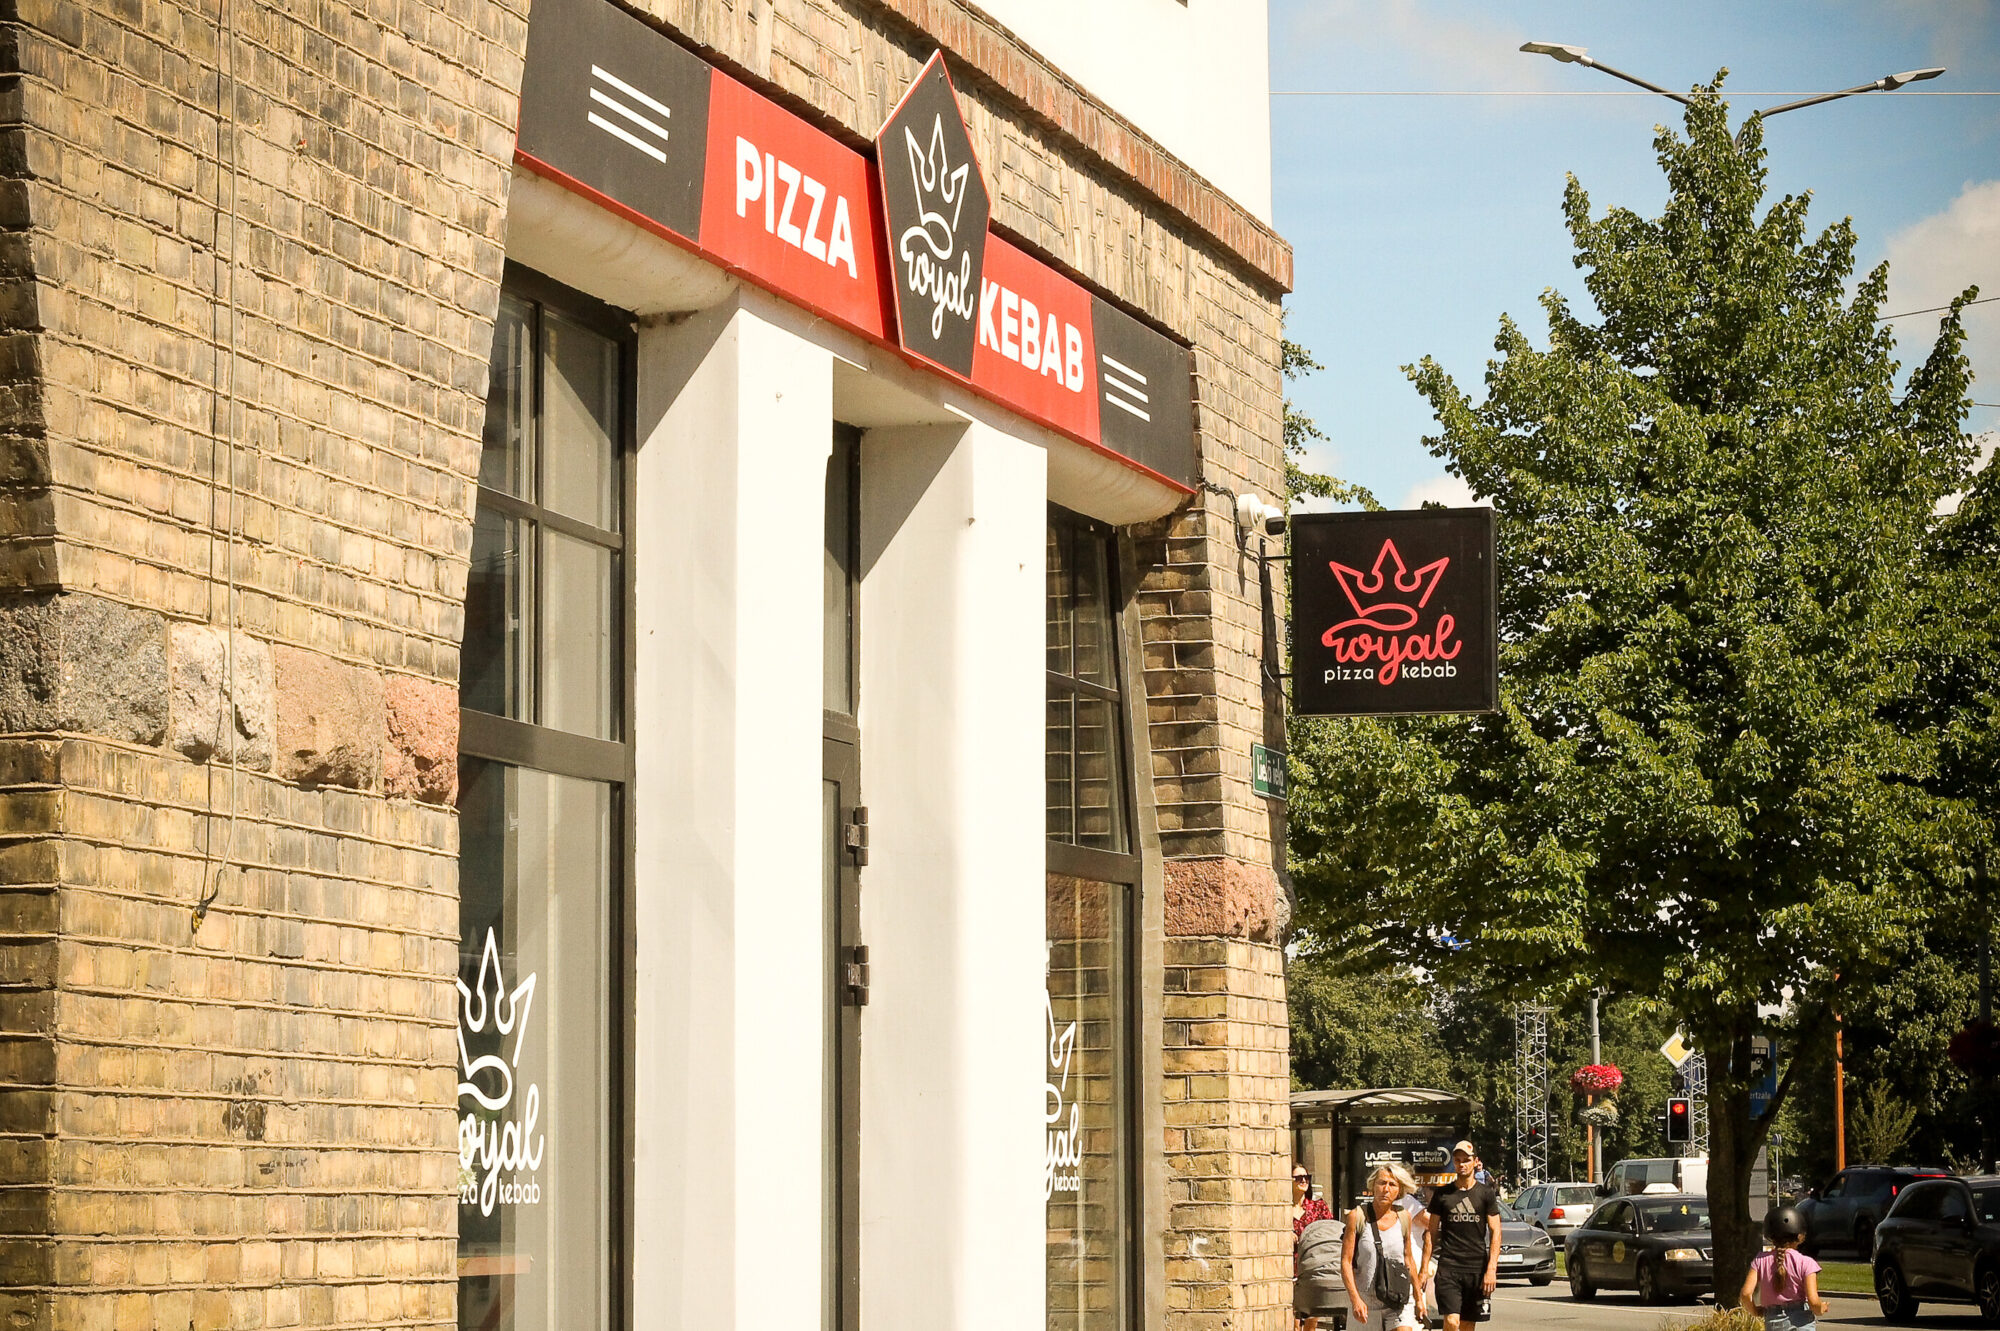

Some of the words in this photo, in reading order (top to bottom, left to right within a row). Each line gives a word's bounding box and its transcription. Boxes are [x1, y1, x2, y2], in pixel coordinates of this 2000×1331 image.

[736, 135, 858, 280] PIZZA
[900, 249, 974, 340] royal
[979, 276, 1084, 393] KEBAB
[1321, 614, 1463, 686] royal
[1324, 665, 1374, 684] pizza
[1401, 663, 1457, 679] kebab
[458, 1083, 544, 1217] oyal
[1054, 1169, 1081, 1192] kebab
[1364, 1151, 1403, 1161] WRC
[499, 1174, 541, 1205] kebab
